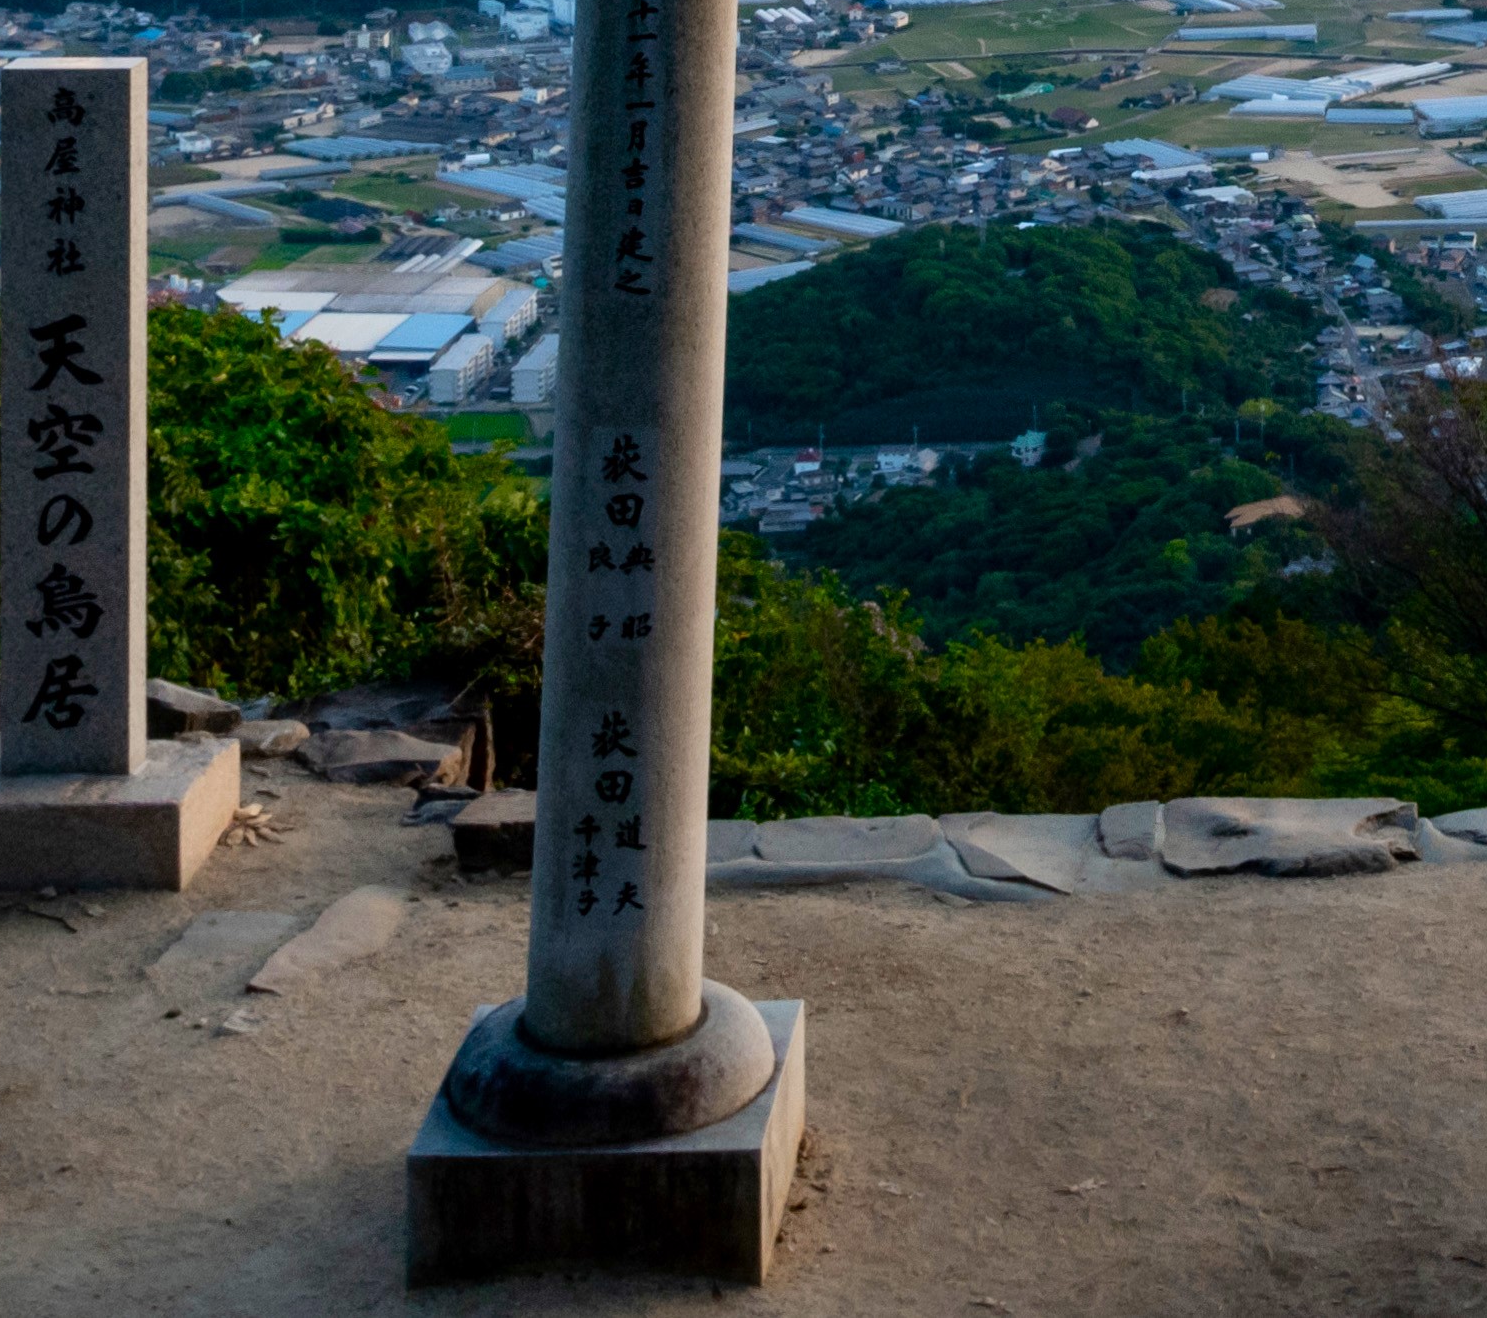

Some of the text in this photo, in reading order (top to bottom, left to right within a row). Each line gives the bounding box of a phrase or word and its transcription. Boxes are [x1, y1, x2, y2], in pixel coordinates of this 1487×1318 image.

[21, 84, 105, 733] 高屋神社 天空の鳥居
[588, 540, 617, 641] 良子
[618, 541, 656, 640] 典昭
[572, 813, 602, 916] 千津子
[612, 814, 648, 916] 道夫
